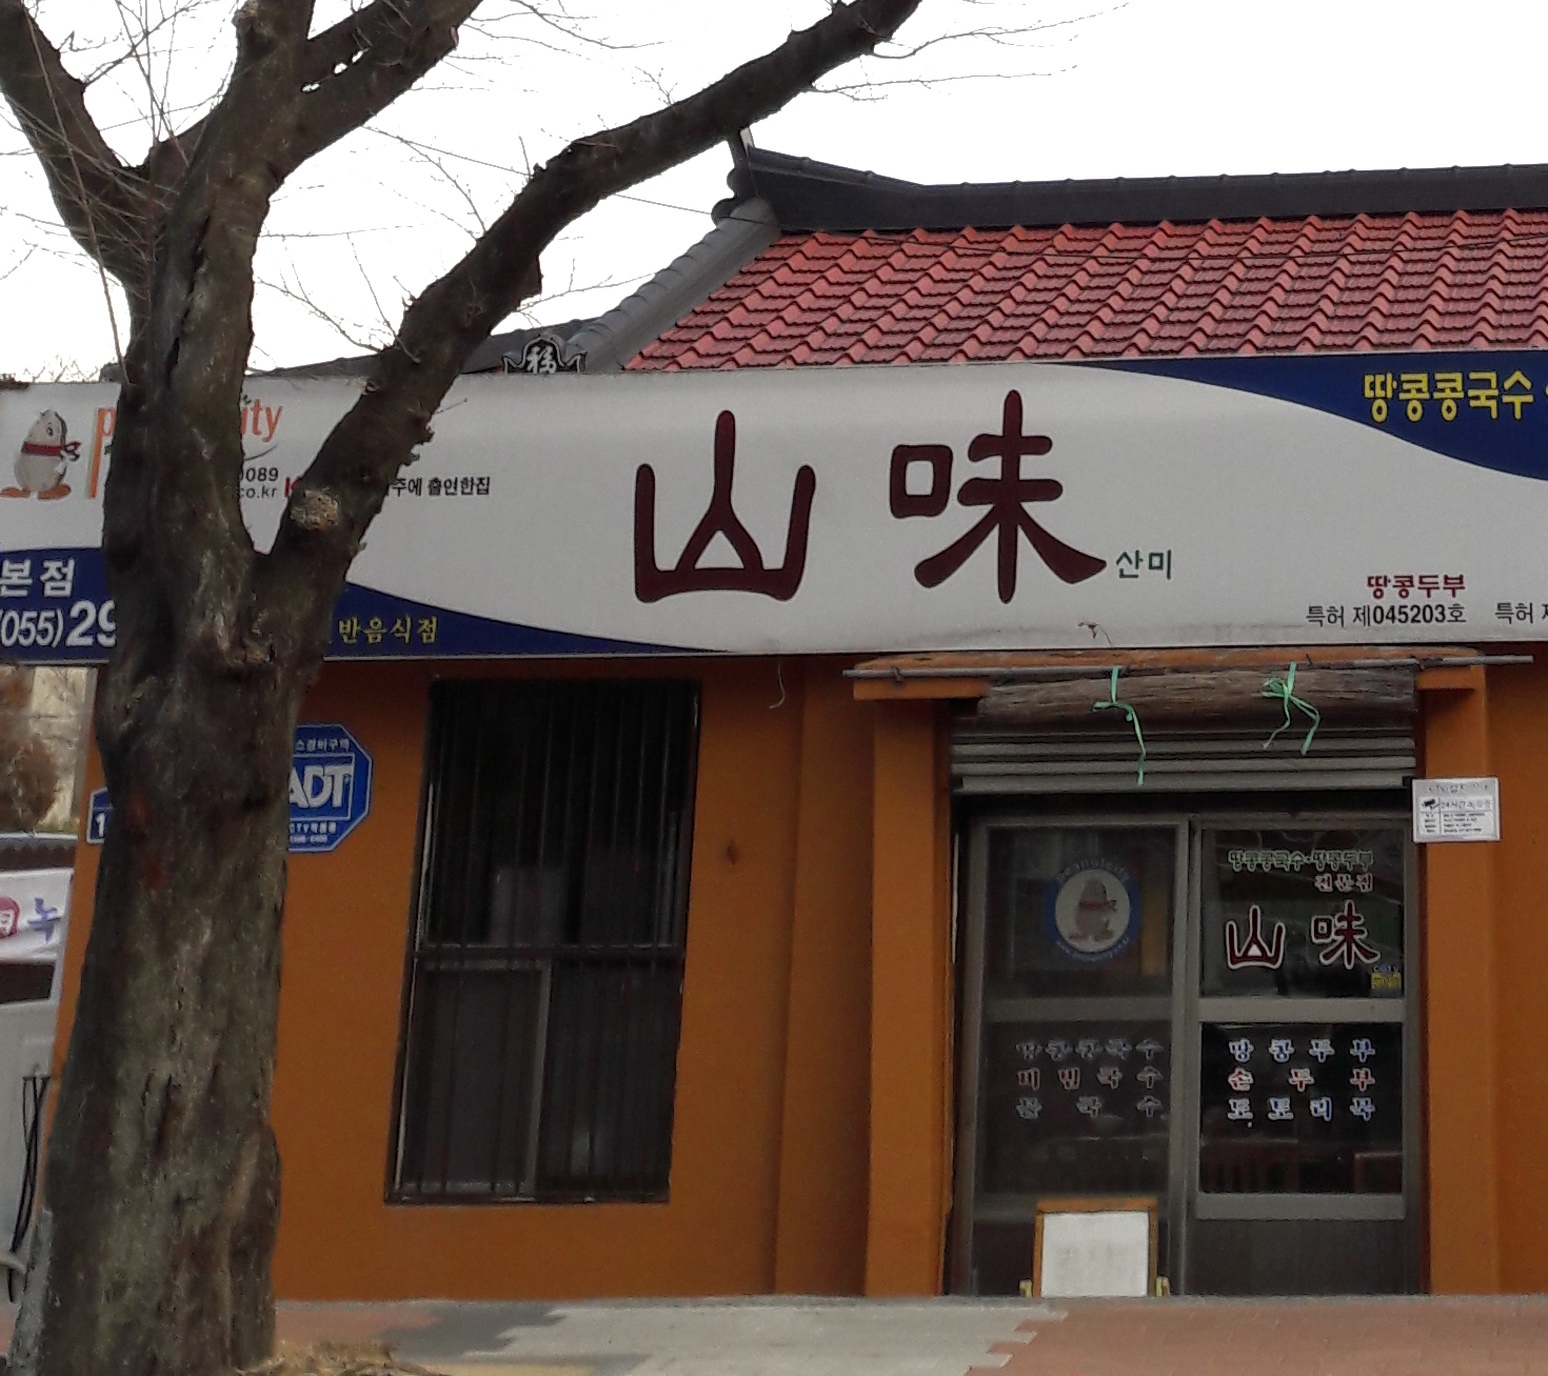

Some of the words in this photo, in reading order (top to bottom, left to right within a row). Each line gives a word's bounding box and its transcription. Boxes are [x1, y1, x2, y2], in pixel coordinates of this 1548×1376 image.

[1364, 369, 1535, 423] 땅콩콩국수
[386, 477, 422, 498] 주에
[0, 558, 75, 598] 본점
[1114, 549, 1173, 581] 산미
[1366, 574, 1467, 599] 땅콩두부
[1305, 604, 1346, 627] 특허
[1352, 603, 1467, 627] 제045203호
[1494, 601, 1534, 625] 특허
[338, 615, 438, 644] 반음식점
[288, 764, 355, 809] ADT
